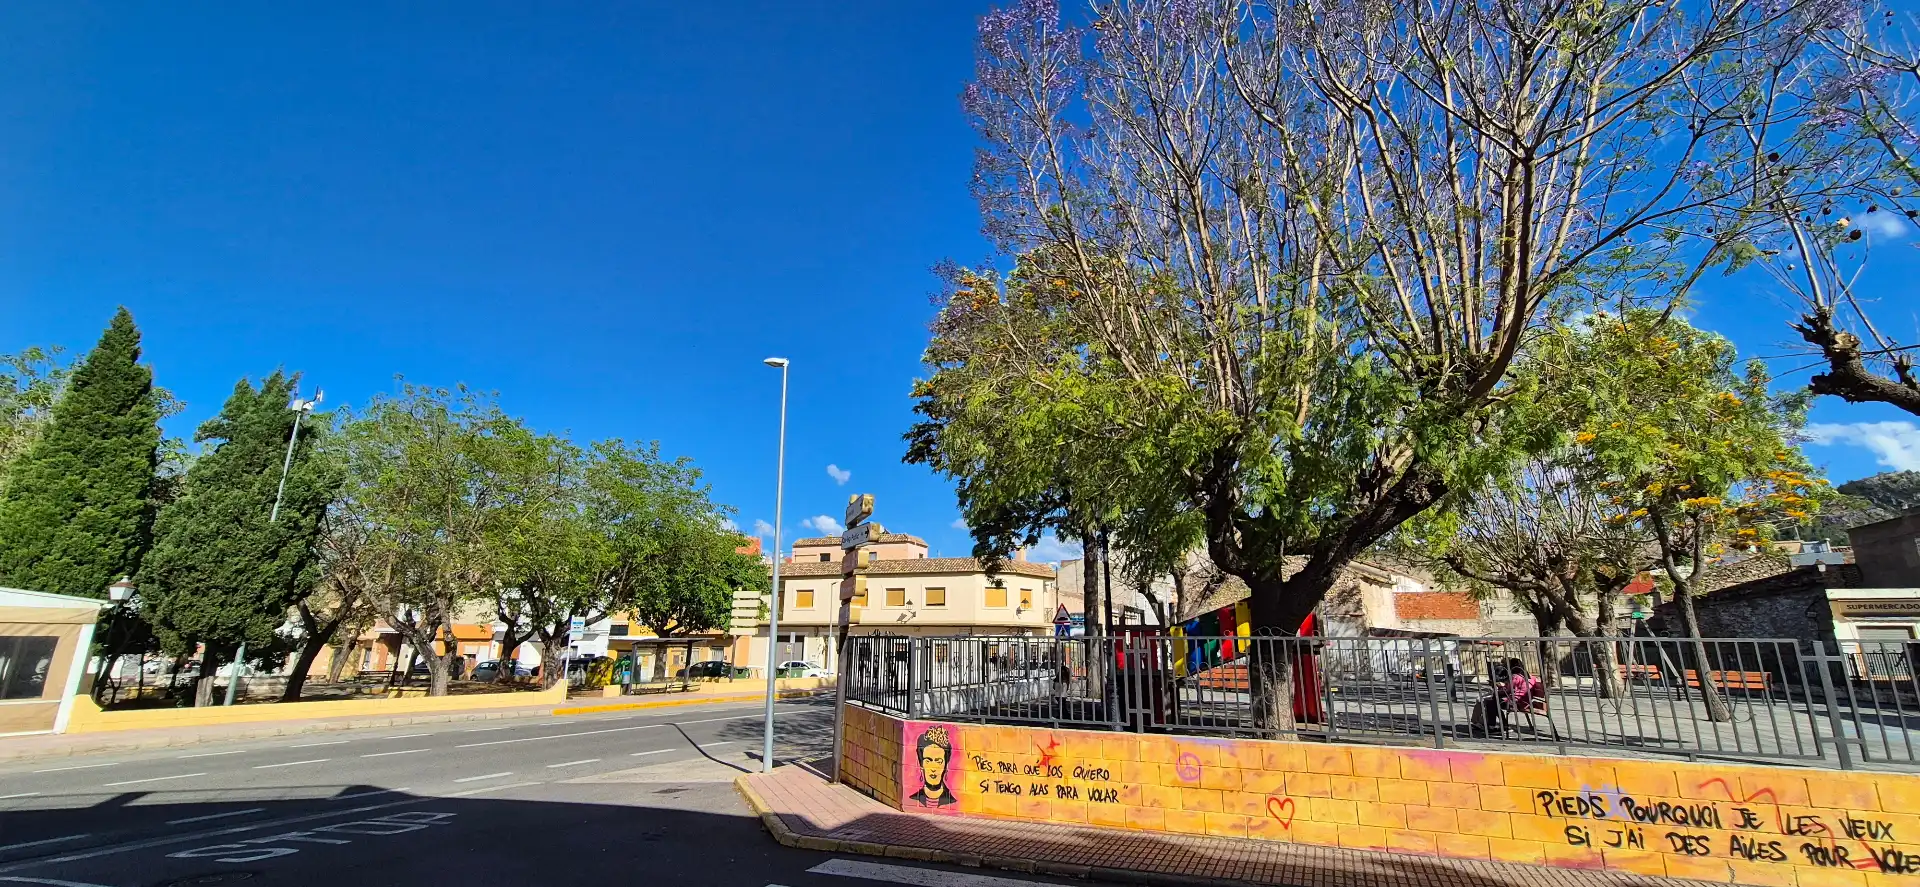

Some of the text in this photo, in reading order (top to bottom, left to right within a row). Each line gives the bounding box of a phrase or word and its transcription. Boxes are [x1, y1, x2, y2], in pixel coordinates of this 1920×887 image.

[997, 761, 1018, 774] PARA
[1047, 764, 1063, 779] LOS
[994, 780, 1021, 795] TENGO
[1029, 782, 1049, 796] ALAS
[1056, 784, 1079, 800] PARA
[165, 811, 457, 863] STOP
[1731, 808, 1764, 830] JE
[1786, 813, 1827, 836] LES
[1839, 818, 1895, 841] VEUX
[1665, 832, 1711, 857] DES
[1800, 843, 1856, 869] POUR
